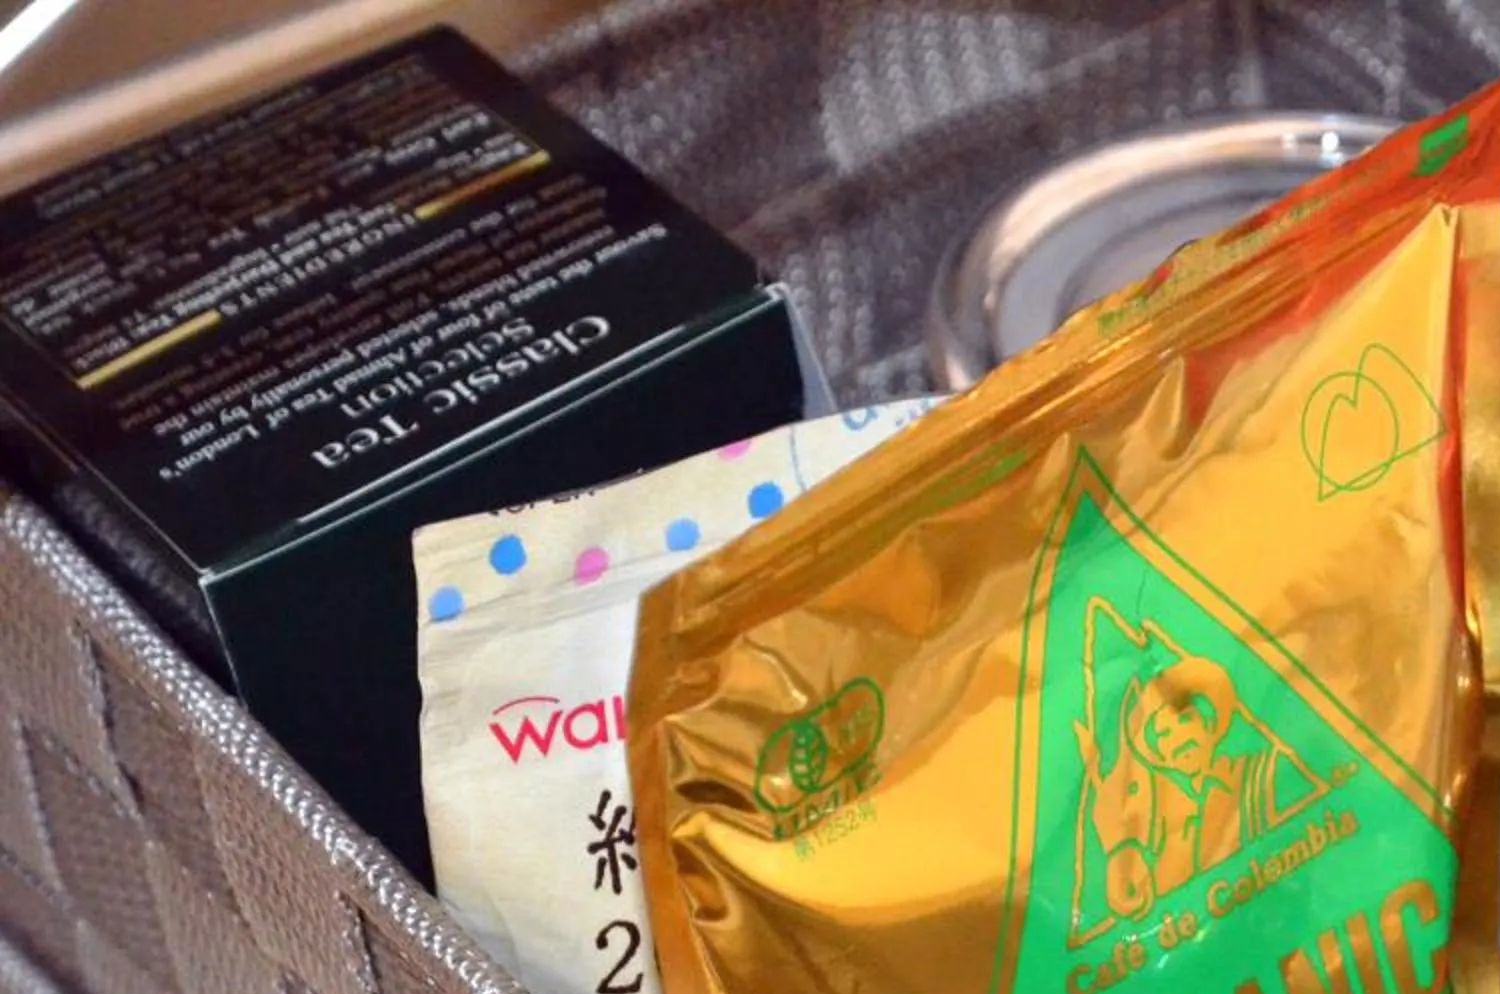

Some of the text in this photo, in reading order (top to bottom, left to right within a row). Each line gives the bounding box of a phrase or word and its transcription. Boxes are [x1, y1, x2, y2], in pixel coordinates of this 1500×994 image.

[214, 211, 419, 317] INGREDIENTS
[242, 347, 358, 413] personally
[307, 309, 620, 474] Classic Tea
[329, 347, 414, 394] Ahmad
[336, 315, 540, 422] Selection
[150, 412, 191, 436] the
[213, 403, 250, 427] by
[259, 405, 295, 430] of
[289, 386, 335, 413] Tea
[156, 422, 262, 482] London's
[175, 420, 217, 447] our
[488, 693, 626, 765] wa
[1158, 912, 1198, 950] de
[1207, 808, 1360, 919] Colombia
